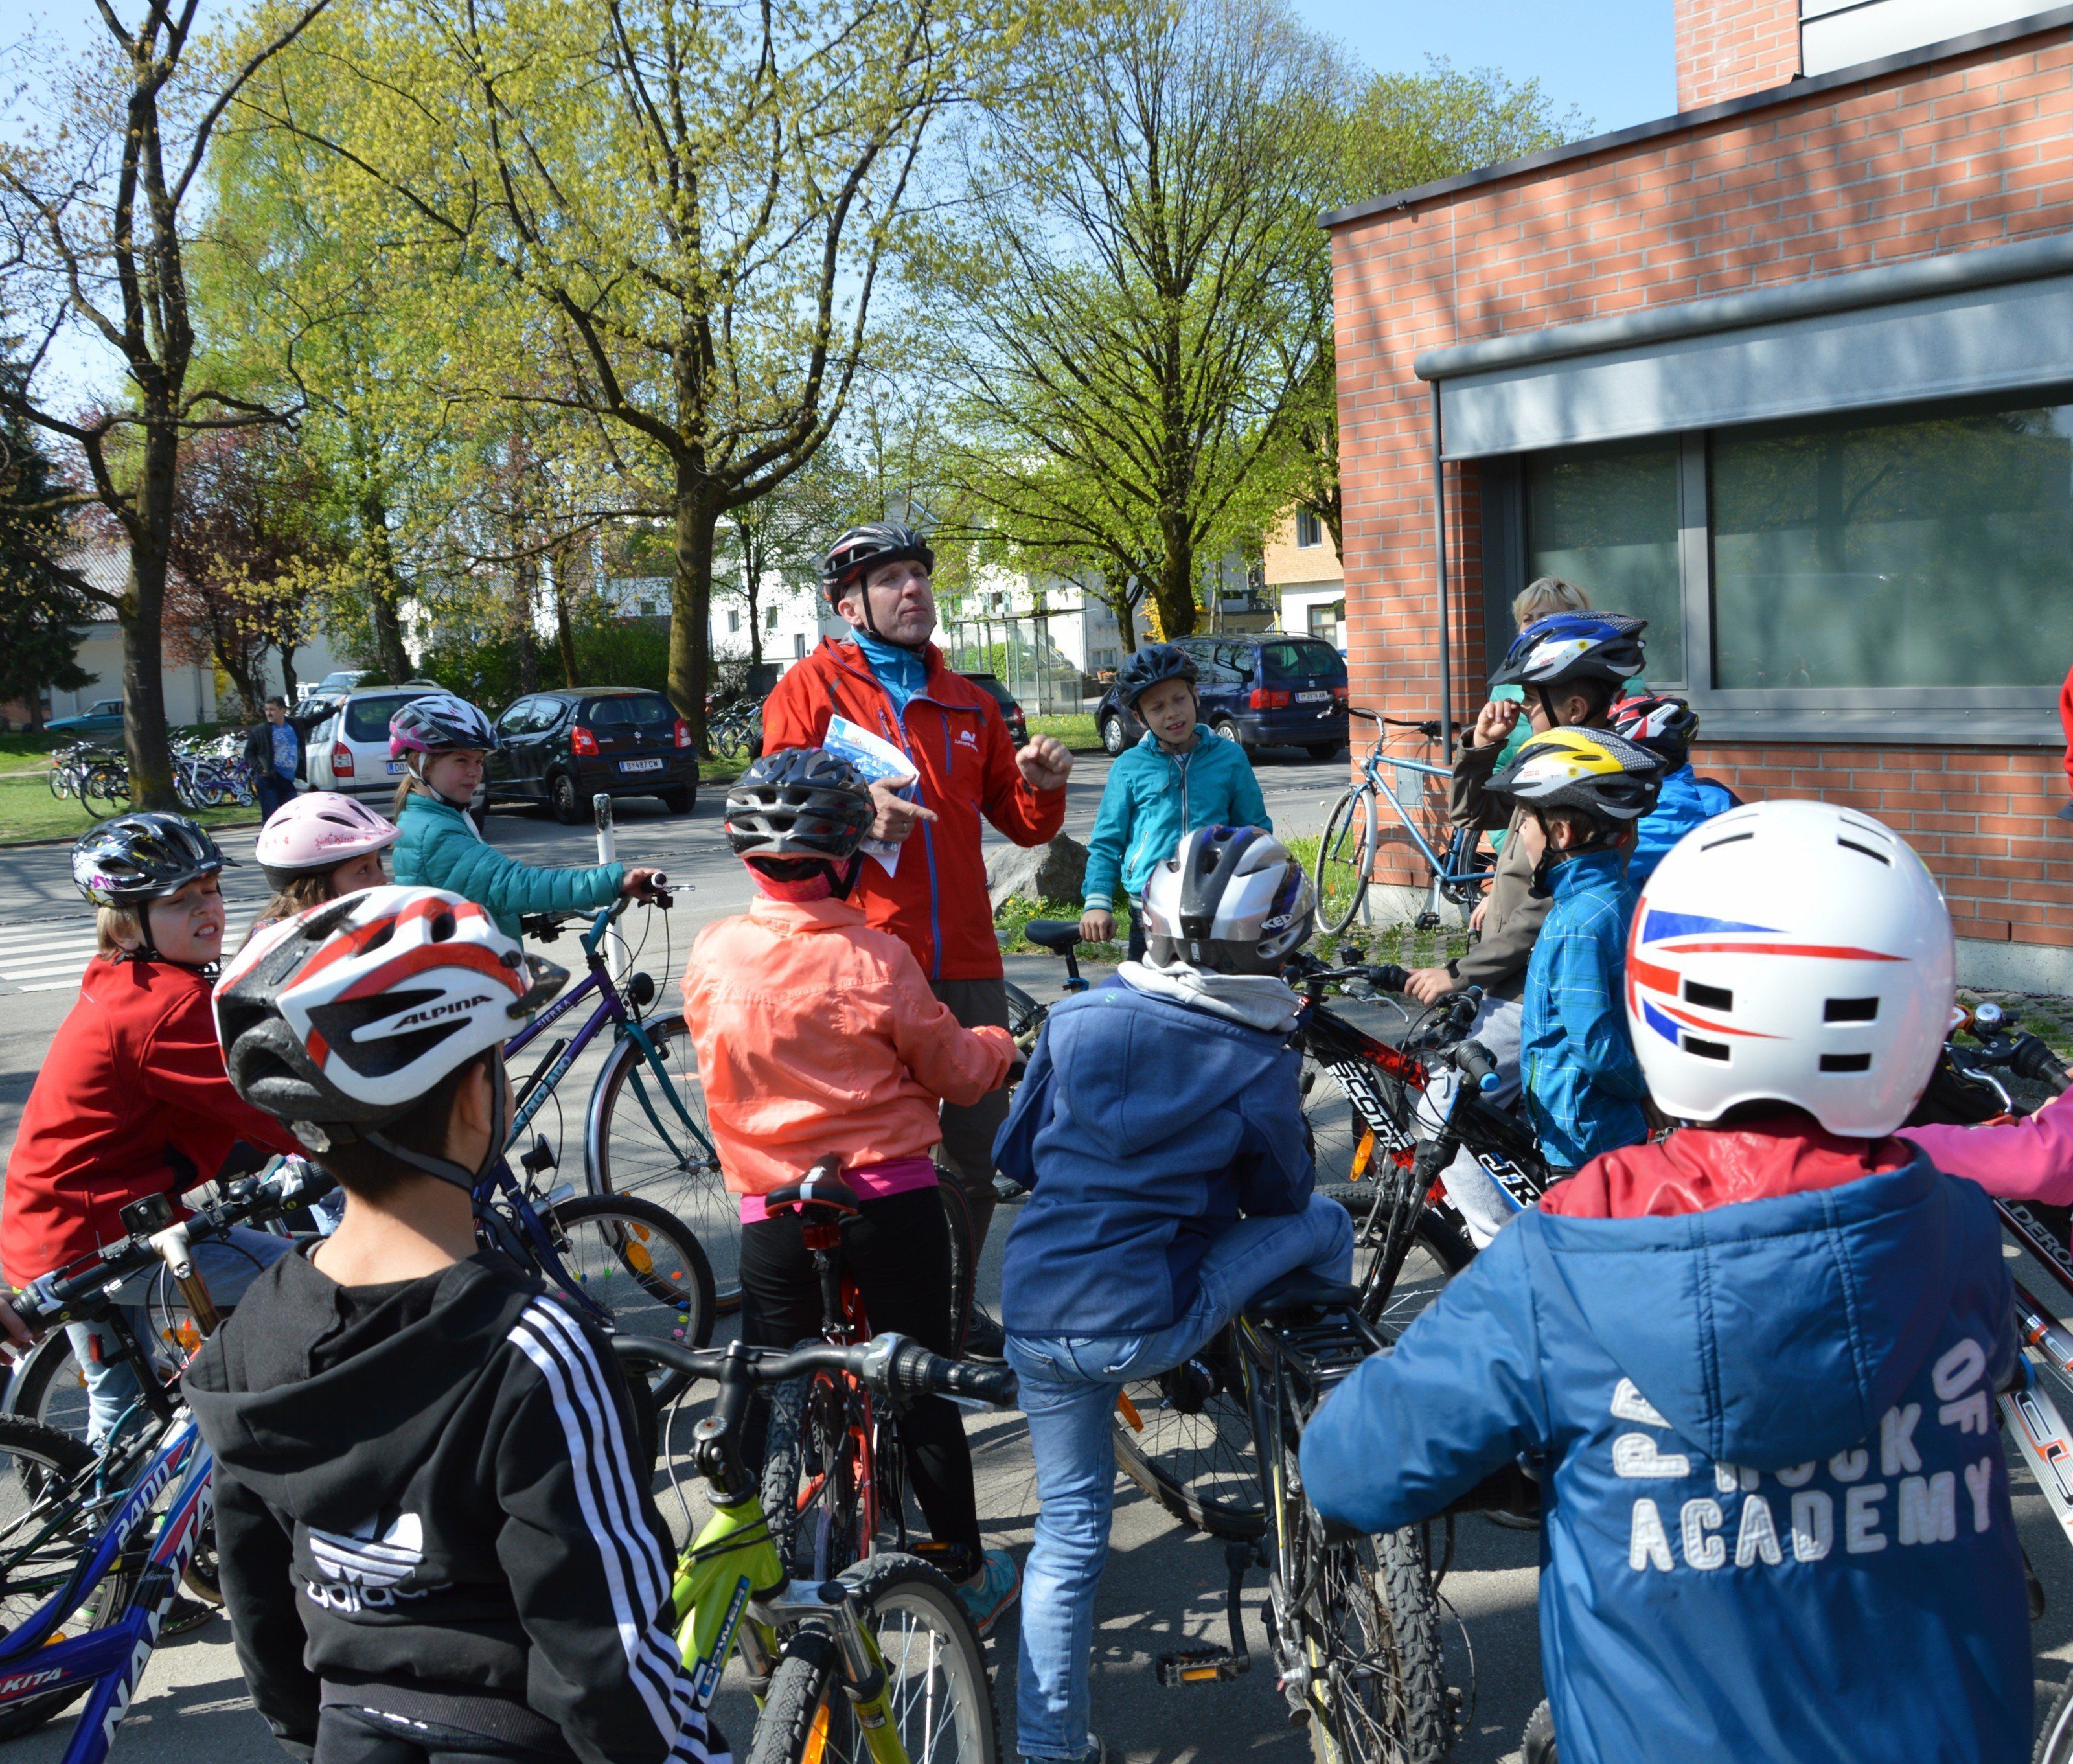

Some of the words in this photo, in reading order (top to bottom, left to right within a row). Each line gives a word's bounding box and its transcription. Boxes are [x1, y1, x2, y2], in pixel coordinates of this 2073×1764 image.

[1261, 914, 1294, 930] KED
[391, 995, 494, 1031] ALPINA
[536, 1000, 571, 1029] SIERRA
[518, 1056, 572, 1125] COLORADO
[1478, 1154, 1542, 1209] JR
[1995, 1196, 2073, 1273] LDERO
[1932, 1338, 1987, 1436] OF
[114, 1460, 170, 1550] 2400
[1629, 1456, 1991, 1572] ACADEMY
[307, 1581, 453, 1612] adid
[704, 1588, 745, 1686] POWER
[0, 1667, 62, 1694] KITA
